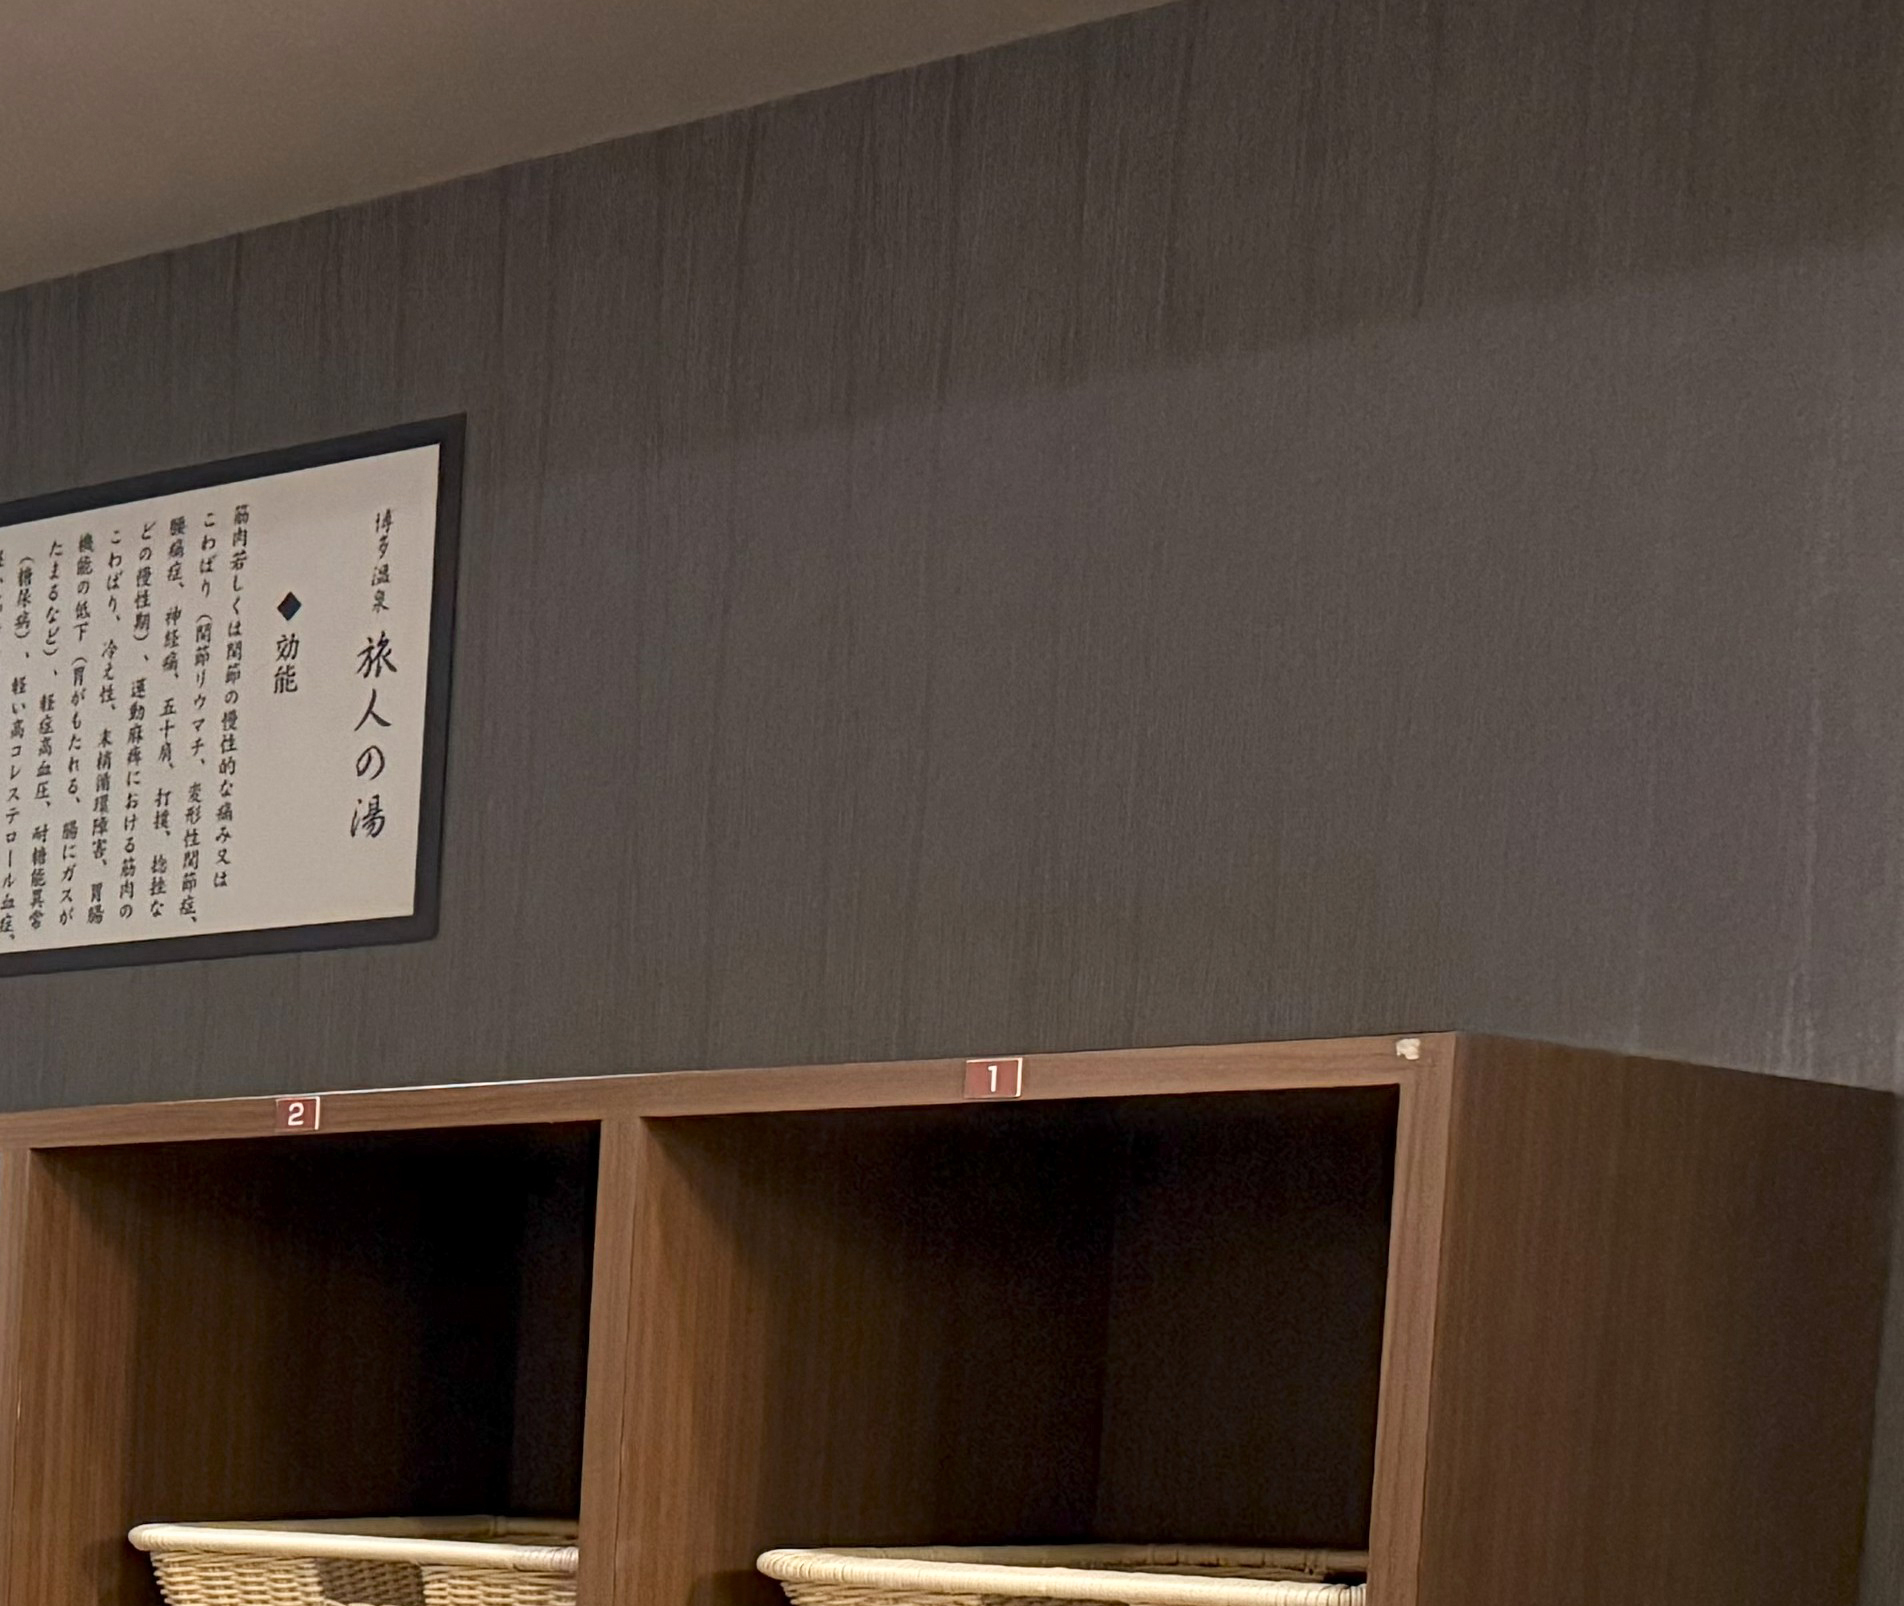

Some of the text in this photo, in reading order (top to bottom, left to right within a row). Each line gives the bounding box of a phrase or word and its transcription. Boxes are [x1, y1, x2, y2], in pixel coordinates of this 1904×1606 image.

[349, 508, 398, 839] 博多温泉 旅人の湯
[987, 1066, 997, 1092] 1
[287, 1103, 305, 1126] 2
